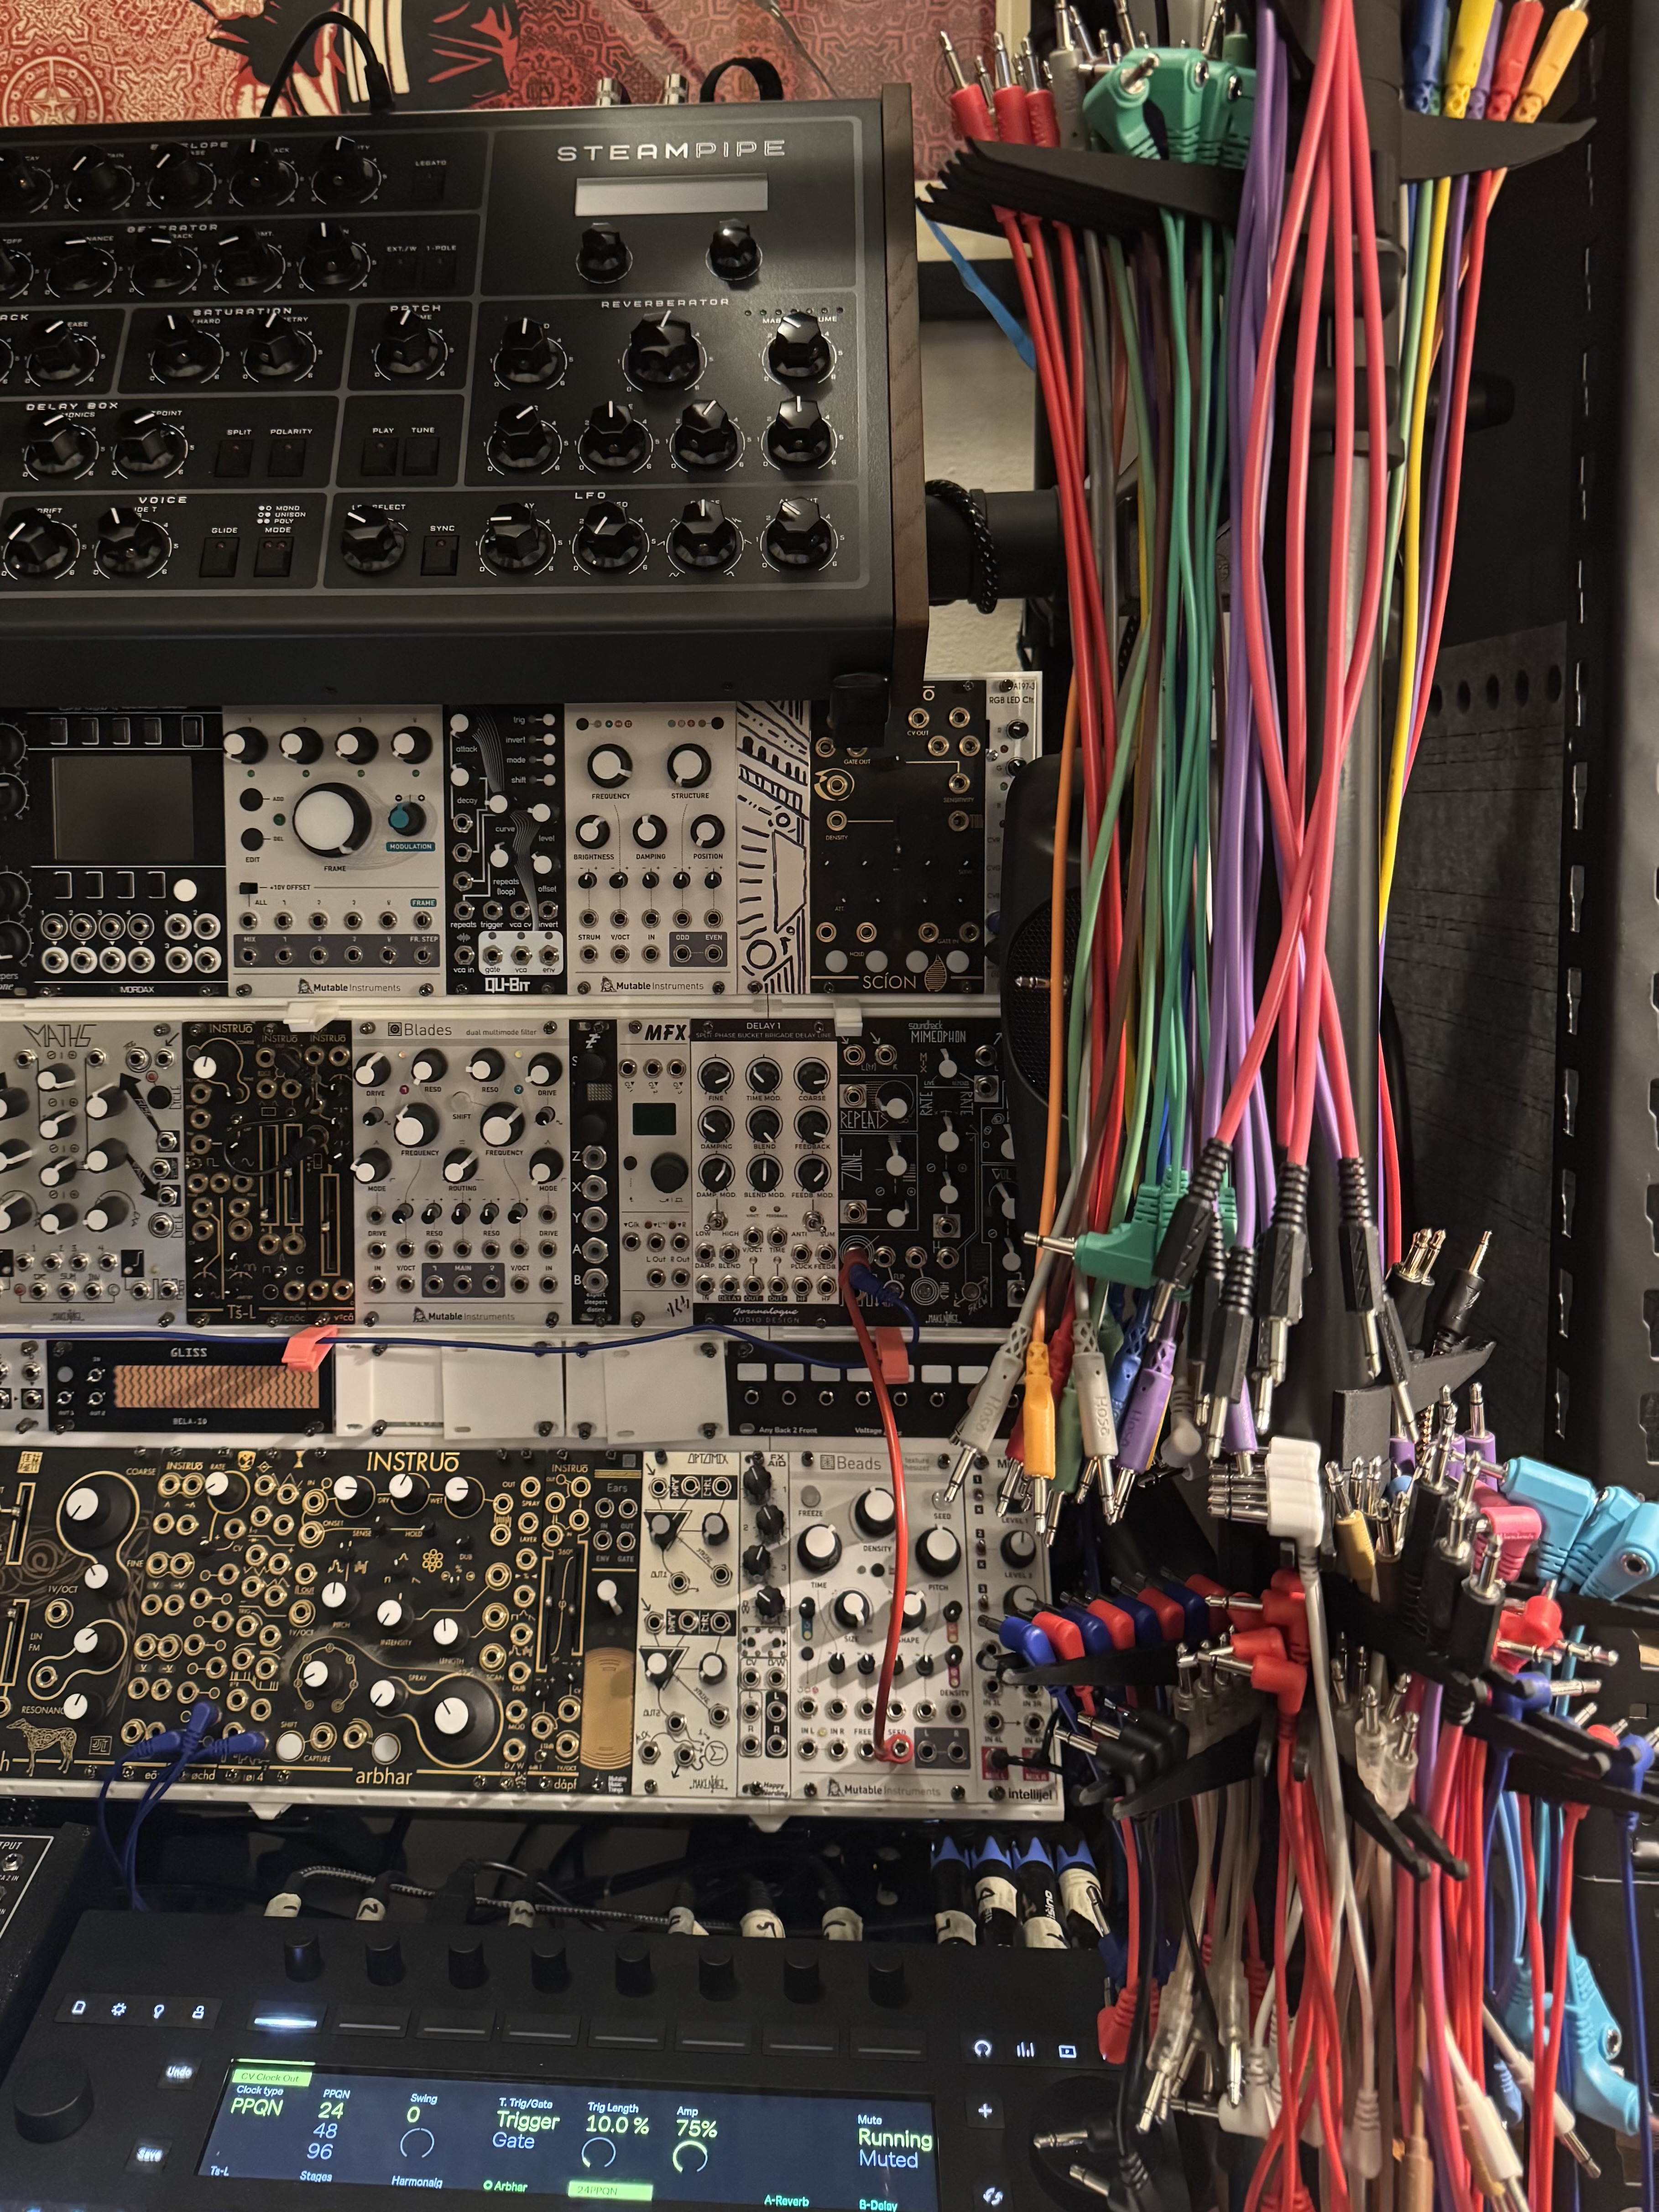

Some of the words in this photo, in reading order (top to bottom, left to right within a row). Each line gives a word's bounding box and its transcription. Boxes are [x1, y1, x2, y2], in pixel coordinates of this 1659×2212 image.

[557, 141, 785, 162] STEAMPIPE
[602, 299, 729, 308] REVERBERATOR
[497, 888, 516, 896] (loop)
[485, 978, 530, 992] QU-BIT
[616, 982, 650, 990] Mutable
[863, 972, 916, 989] SCÍON
[23, 1024, 97, 1048] MATHS
[405, 1024, 452, 1036] Blades
[645, 1024, 687, 1041] MFX
[911, 1031, 966, 1043] MIMEOPHON
[920, 1091, 933, 1116] RATE
[840, 1111, 888, 1129] REPEATS
[428, 1312, 462, 1320] Mutable
[464, 1312, 515, 1320] Instruments
[171, 1348, 207, 1357] GLISS
[838, 1456, 882, 1469] Beads
[607, 1484, 627, 1492] Ears
[356, 1767, 412, 1784] arbhar
[1008, 1788, 1052, 1800] intellijel
[167, 2066, 193, 2079] Undo
[241, 2072, 255, 2081] CV
[256, 2073, 282, 2082] Clock
[236, 2085, 263, 2095] Clock
[265, 2087, 283, 2097] type
[323, 2089, 350, 2099] PPQN
[411, 2093, 438, 2105] Swing
[500, 2097, 507, 2107] T.
[510, 2098, 553, 2110] Trig/Gate
[230, 2097, 283, 2116] PPQN
[318, 2102, 344, 2119] 24
[588, 2102, 605, 2113] Trig
[607, 2102, 639, 2114] Length
[677, 2106, 699, 2117] Amp
[407, 2107, 420, 2123] 0
[497, 2110, 560, 2132] Trigger
[858, 2115, 882, 2125] Mute
[313, 2123, 338, 2139] 48
[586, 2115, 629, 2133] 10.0
[633, 2117, 649, 2135] %
[676, 2119, 718, 2138] 75%
[492, 2132, 535, 2149] Gate
[859, 2128, 933, 2152] Running
[137, 2147, 163, 2162] Save
[307, 2143, 334, 2160] 96
[859, 2149, 918, 2169] Muted
[211, 2166, 229, 2176] Ts-L
[300, 2171, 333, 2182] Stages
[391, 2176, 443, 2189] Harmonaig
[494, 2181, 528, 2192] Arbhar
[577, 2186, 618, 2196] 24PPQN
[764, 2195, 809, 2207] A-Reverb
[859, 2200, 897, 2212] B-Delay
